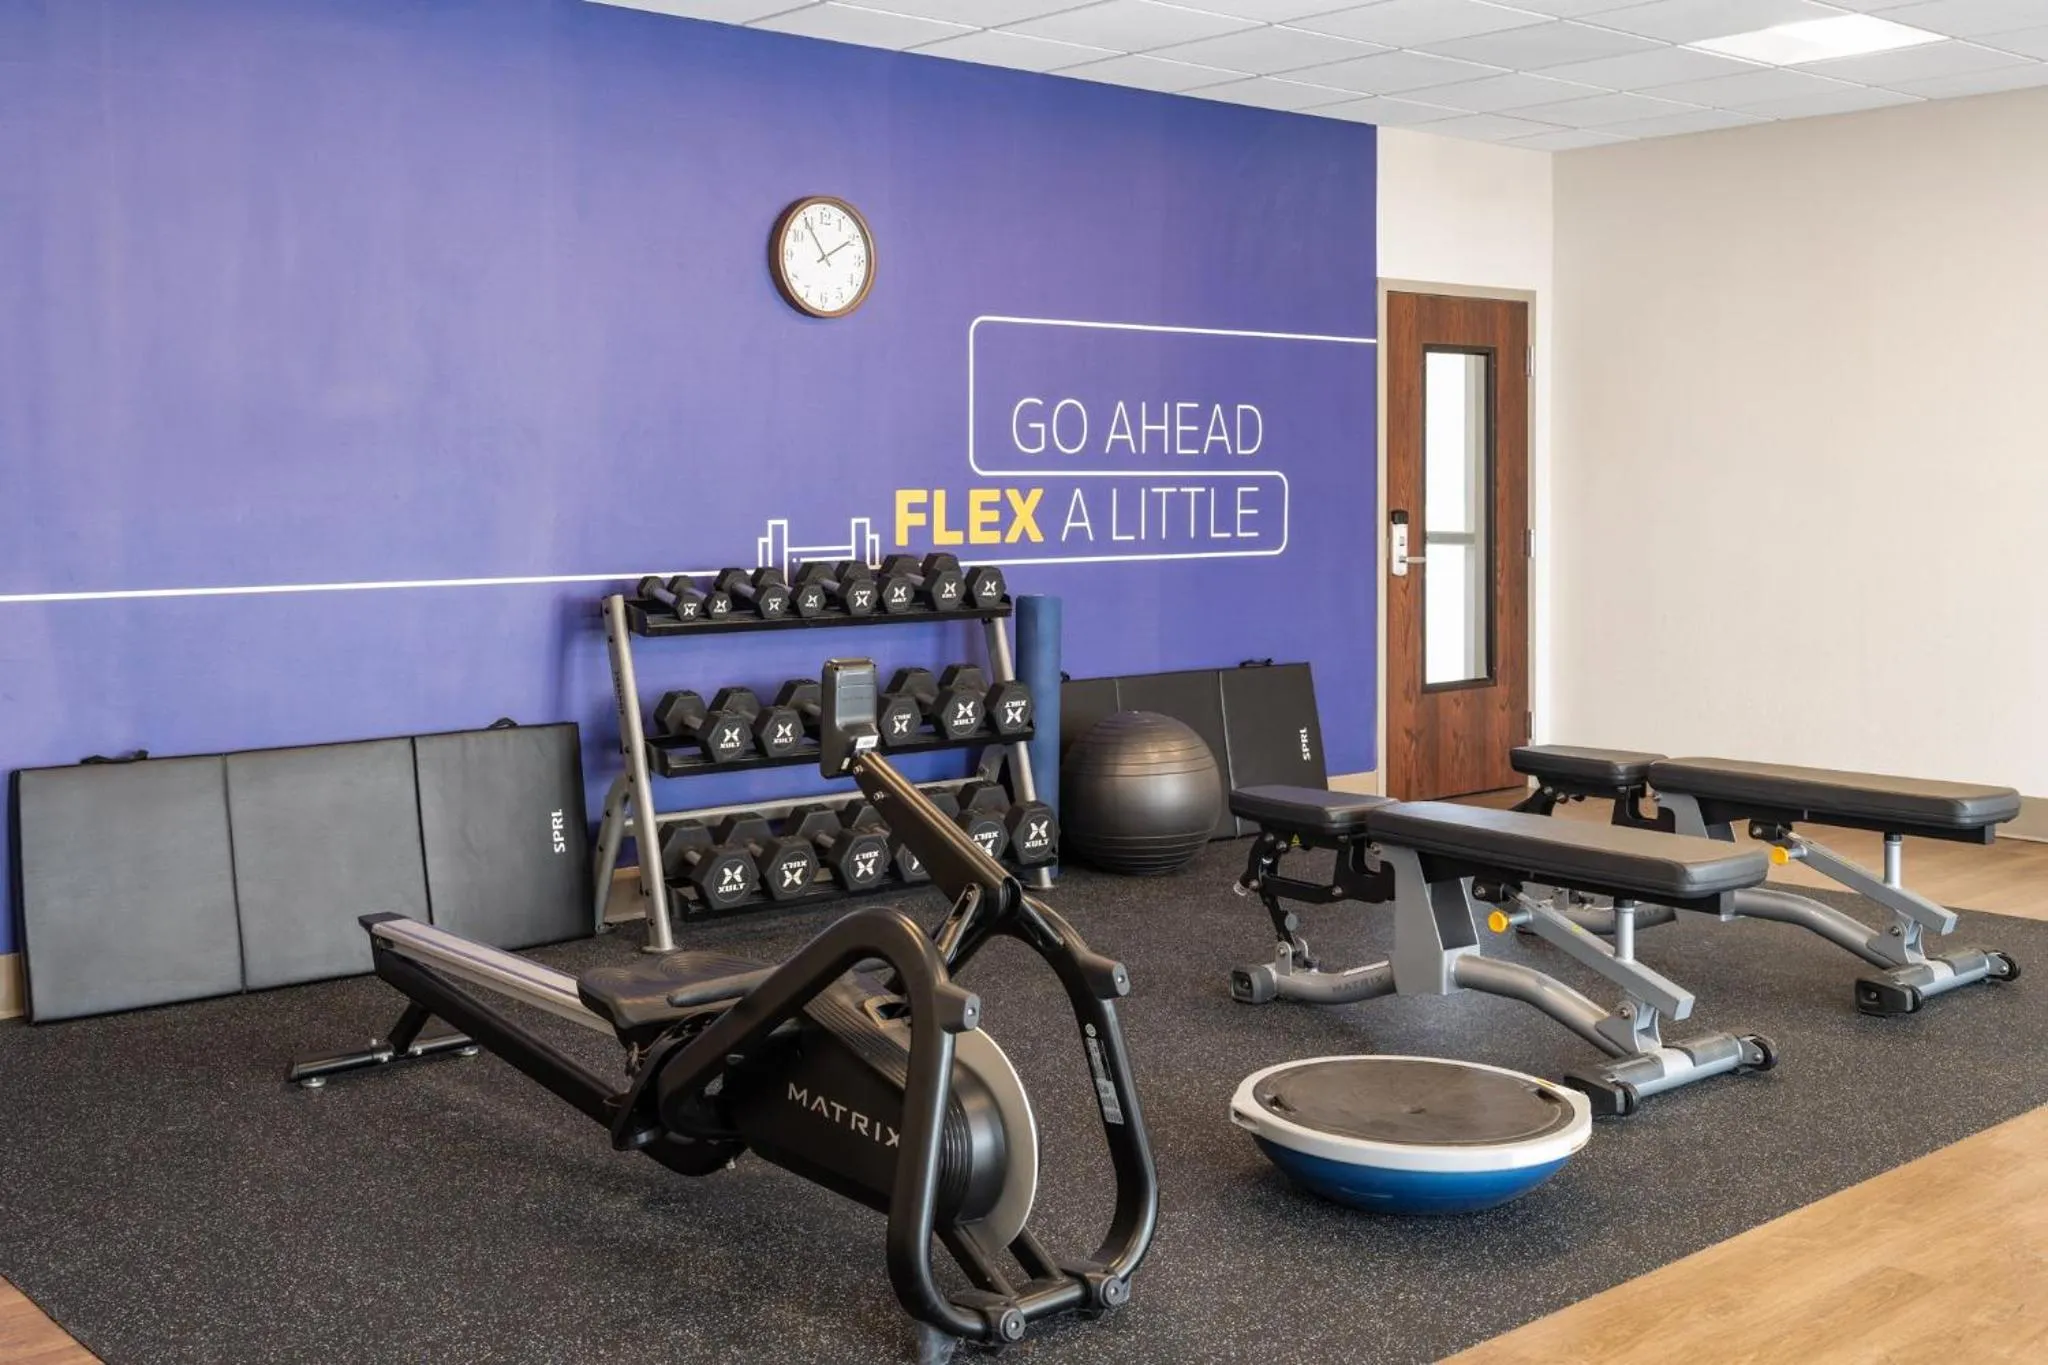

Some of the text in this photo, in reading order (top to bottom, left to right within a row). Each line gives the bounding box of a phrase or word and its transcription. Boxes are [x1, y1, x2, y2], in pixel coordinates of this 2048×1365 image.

[1012, 397, 1263, 455] GO AHEAD
[895, 486, 1259, 546] FLEX A LITTLE
[1024, 838, 1049, 849] XULT
[853, 850, 879, 861] XULT
[780, 860, 807, 870] XULT
[718, 882, 746, 893] XULT
[788, 1081, 901, 1148] MATRIX
